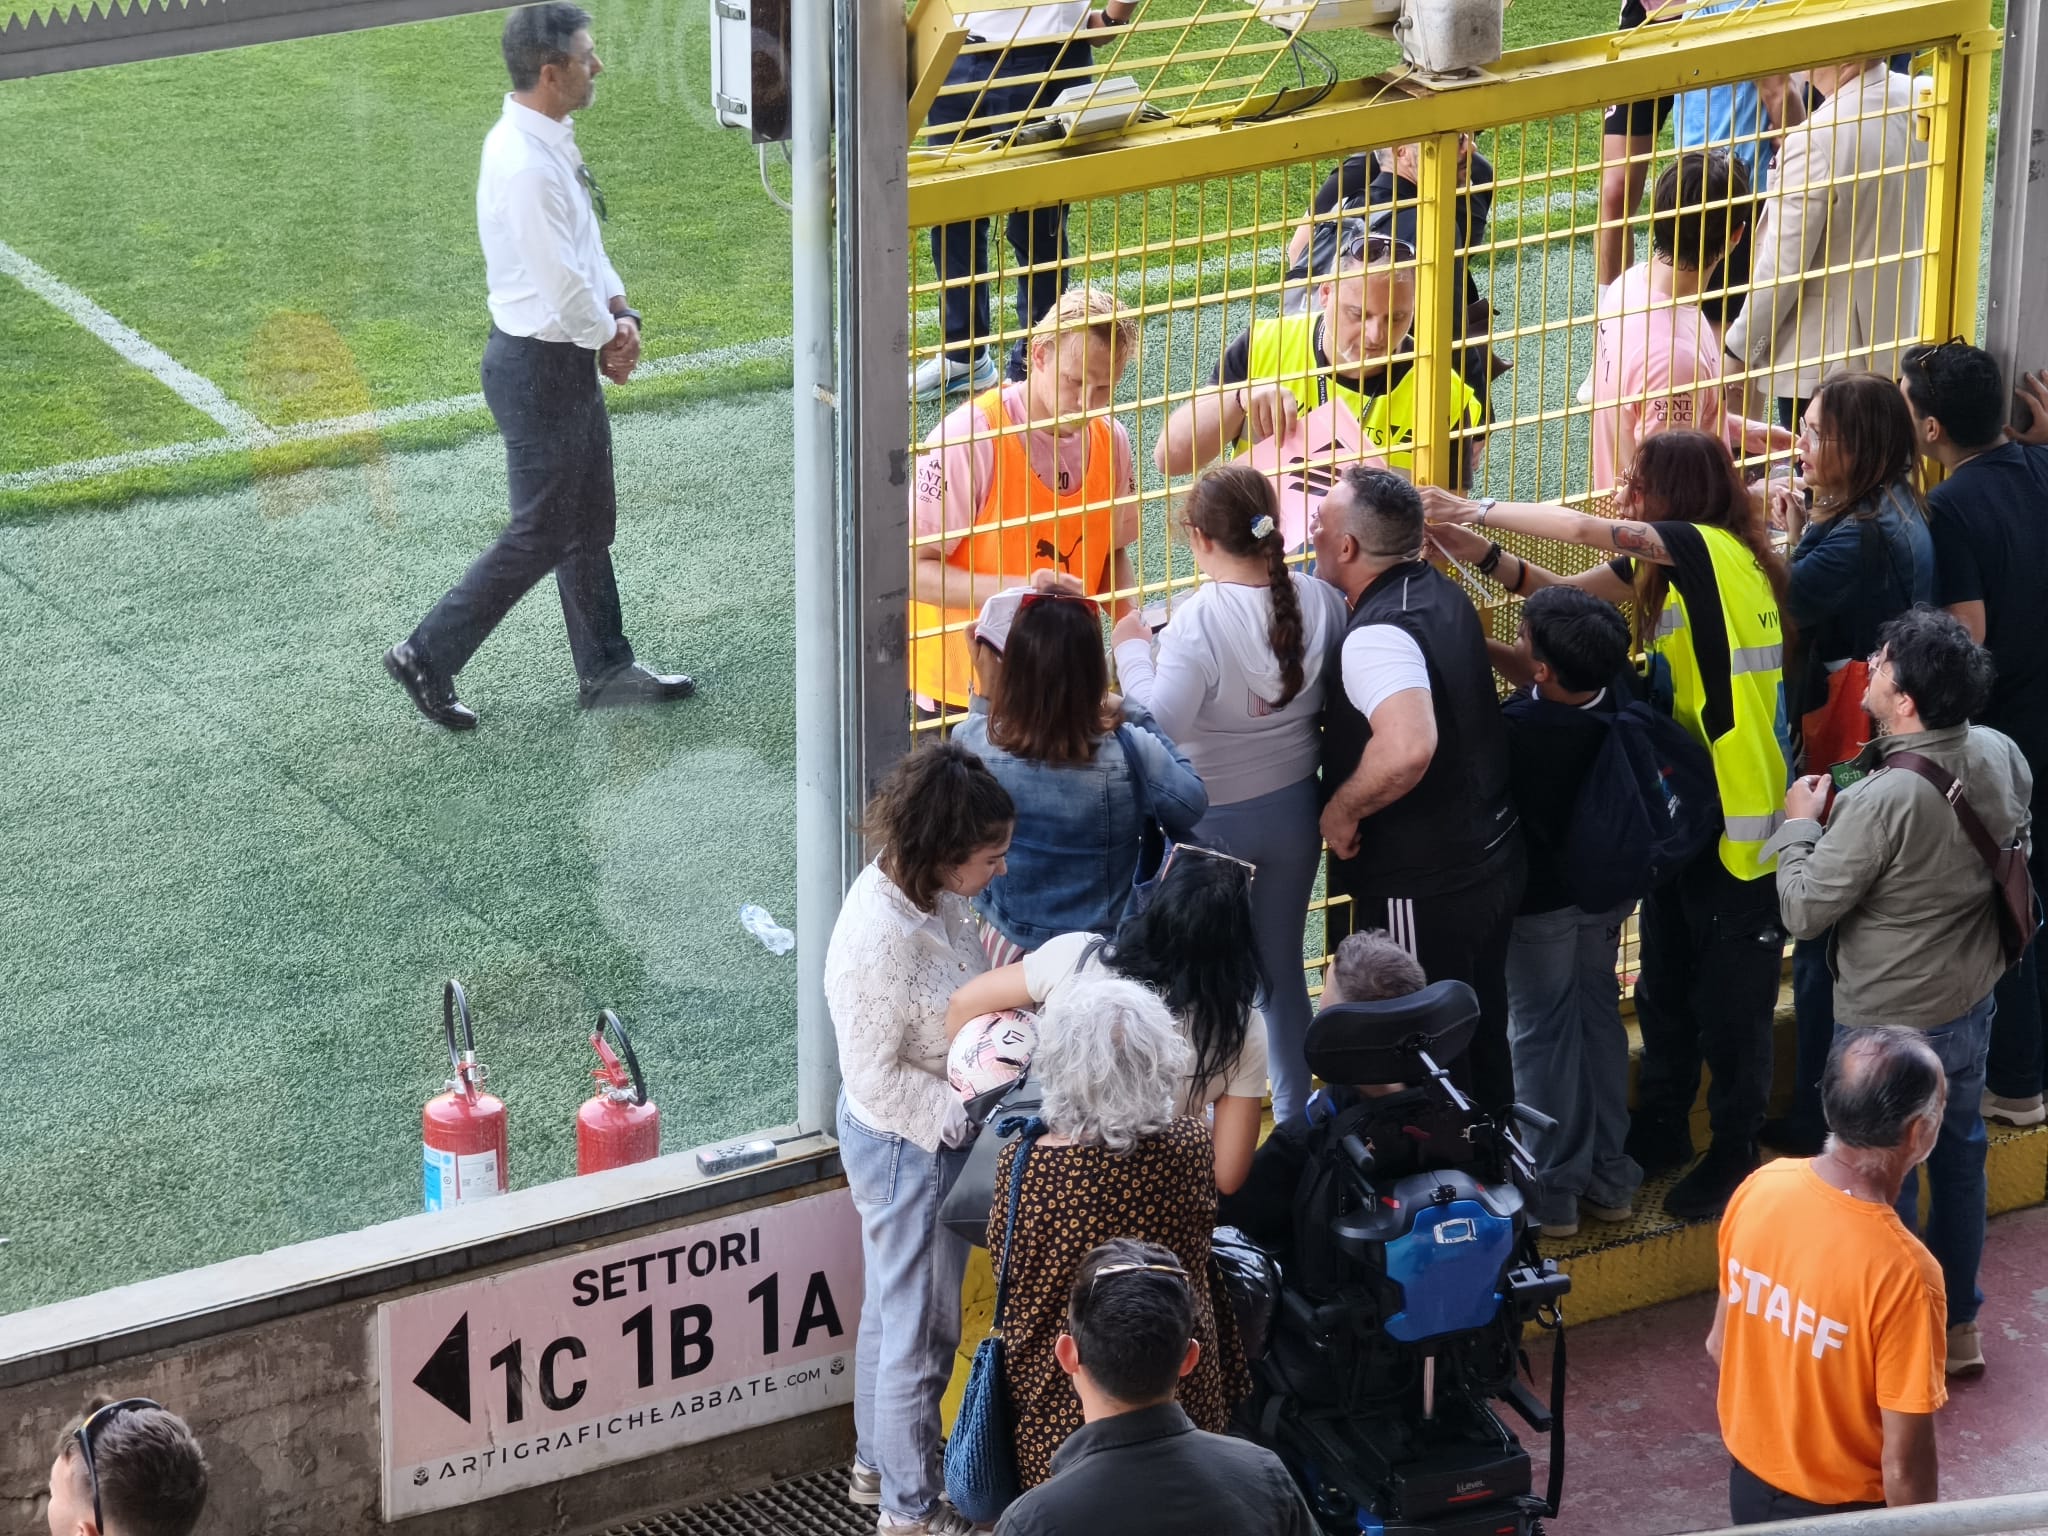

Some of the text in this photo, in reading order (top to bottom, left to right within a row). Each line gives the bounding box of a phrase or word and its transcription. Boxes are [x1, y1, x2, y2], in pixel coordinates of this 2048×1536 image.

[572, 1227, 760, 1307] SETTORI
[1727, 1257, 1849, 1360] STAFF
[490, 1270, 844, 1424] 1C 1B 1A
